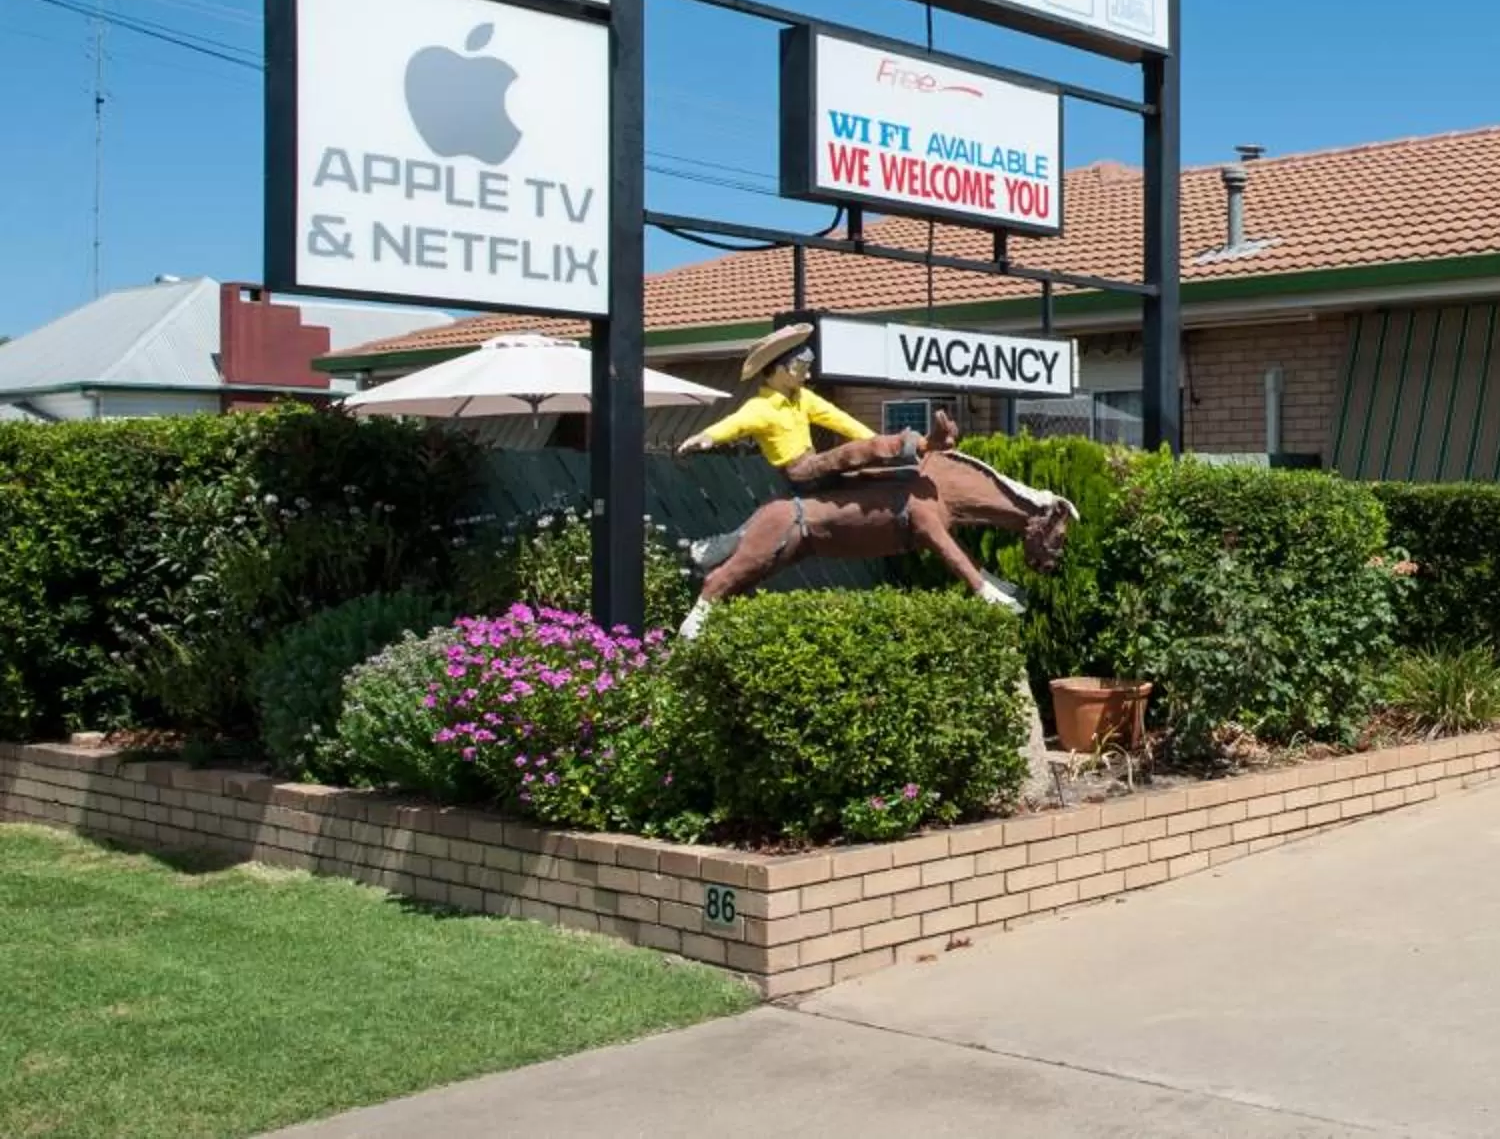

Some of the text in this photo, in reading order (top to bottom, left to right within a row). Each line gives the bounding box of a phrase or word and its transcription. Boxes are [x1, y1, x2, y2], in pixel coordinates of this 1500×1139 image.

[876, 59, 937, 91] Free
[828, 109, 1048, 180] WI FI AVAILABLE
[313, 147, 594, 223] APPLE TV
[828, 142, 1049, 219] WE WELCOME YOU
[307, 214, 599, 286] & NETFLIX
[900, 334, 1060, 385] VACANCY
[707, 888, 736, 923] 86
